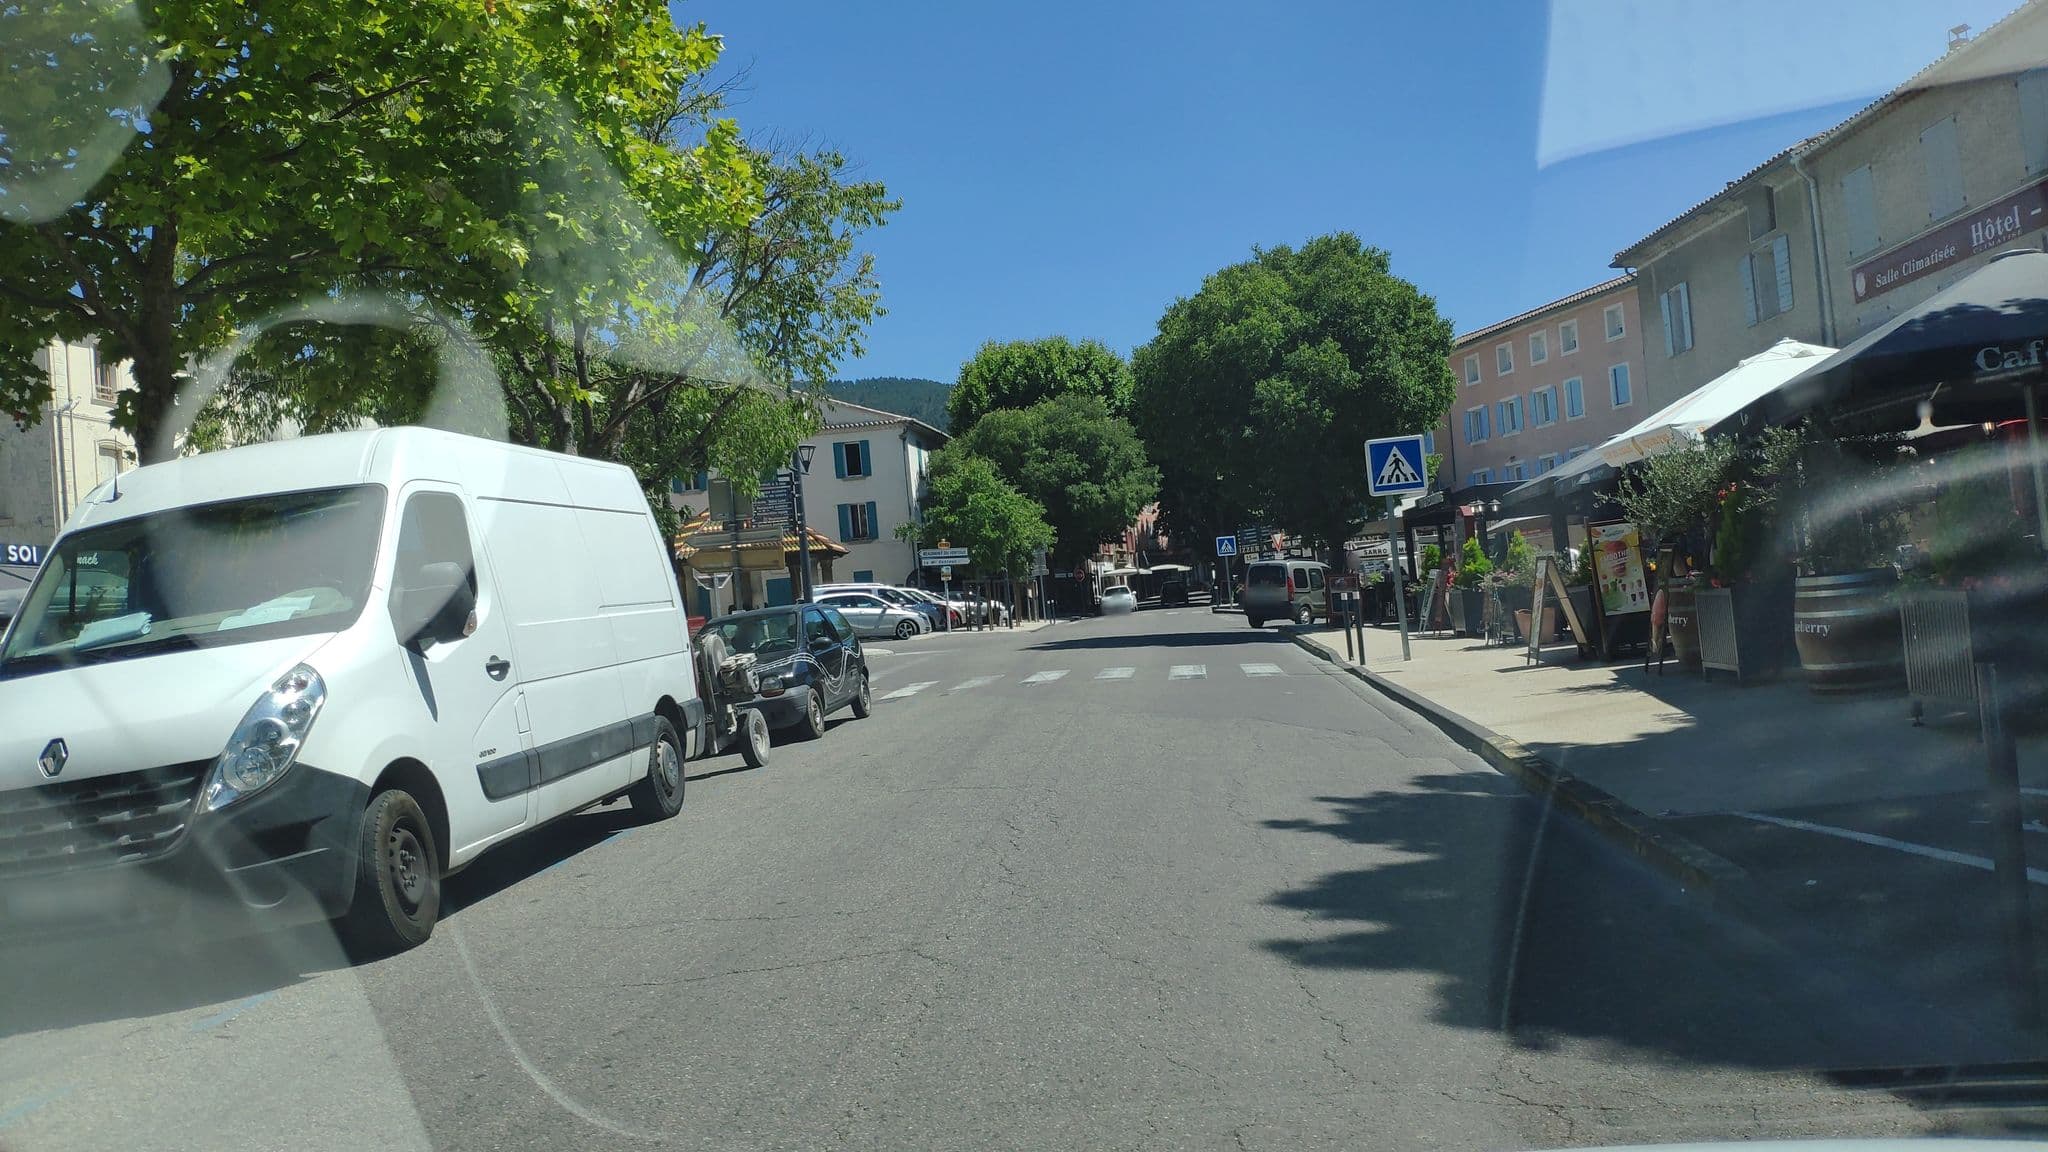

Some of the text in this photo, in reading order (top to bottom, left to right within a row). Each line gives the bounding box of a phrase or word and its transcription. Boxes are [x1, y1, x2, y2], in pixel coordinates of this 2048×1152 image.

[1970, 204, 2021, 248] Hôtel
[1875, 243, 1956, 289] Salle Climatisée
[1976, 339, 2048, 371] Caf
[7, 544, 38, 563] SOI
[77, 552, 99, 565] nack
